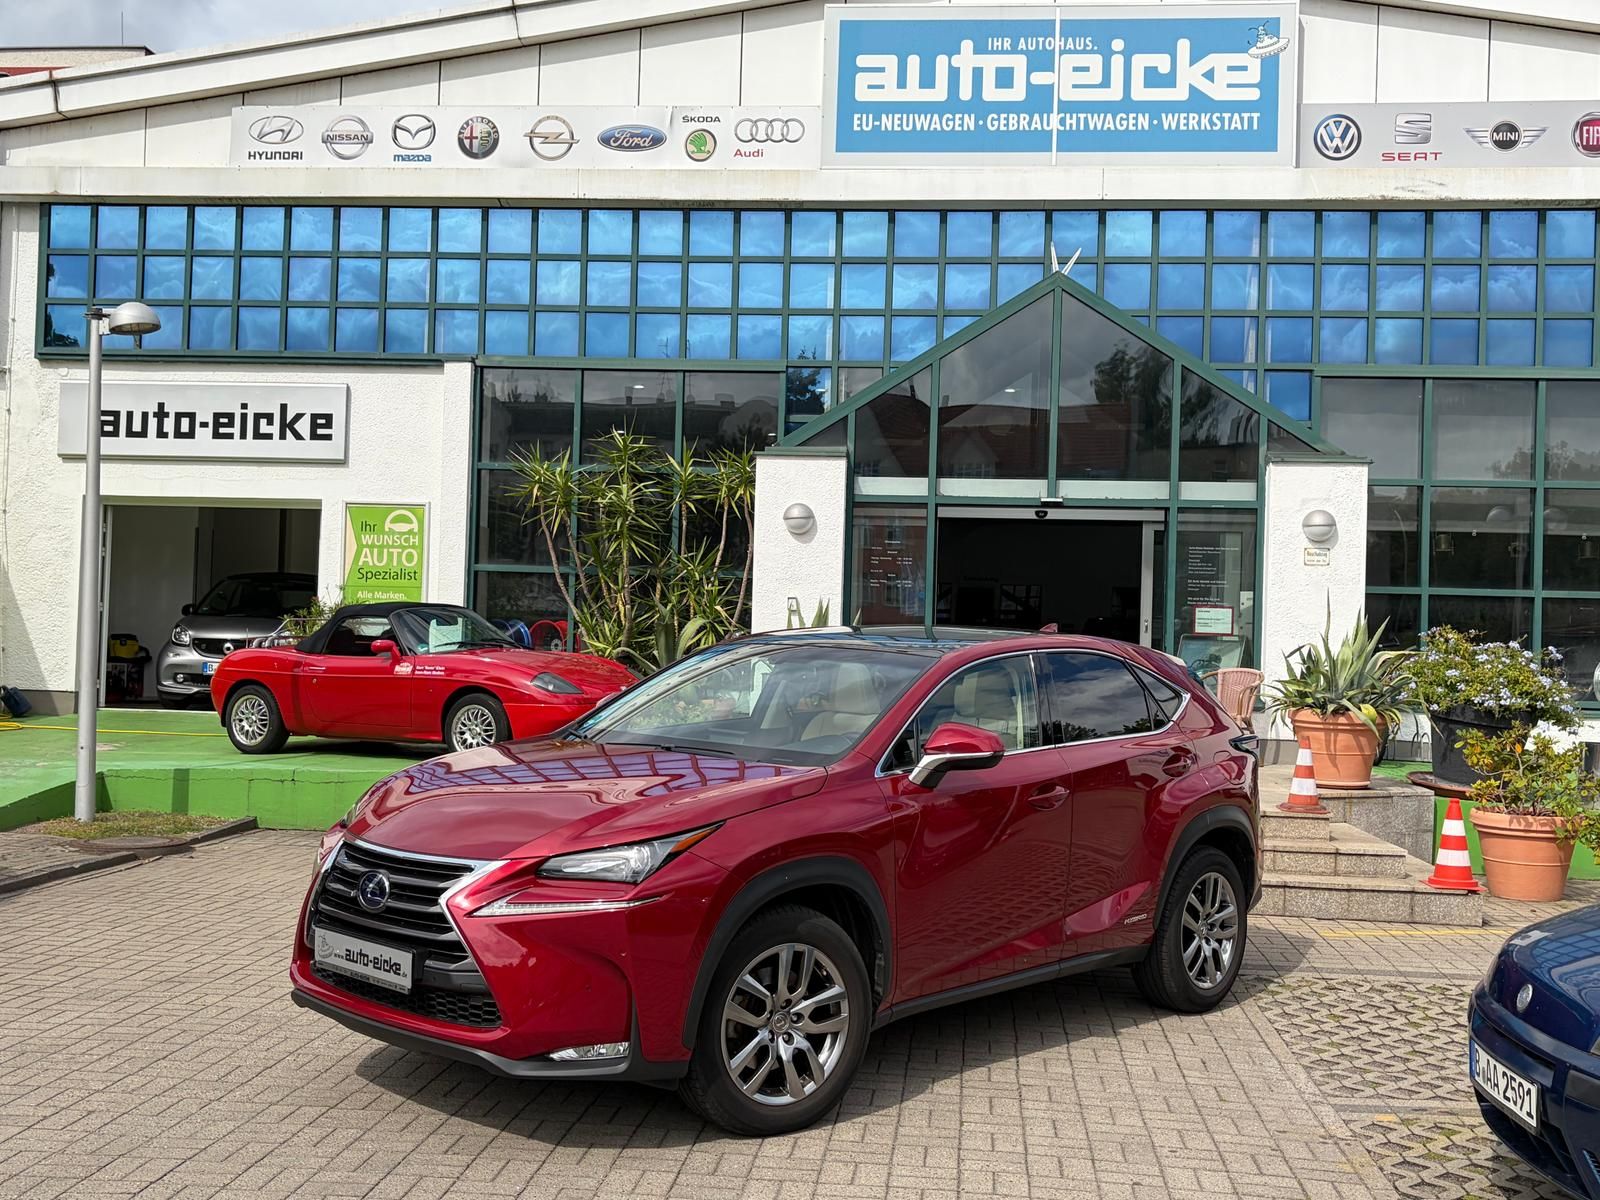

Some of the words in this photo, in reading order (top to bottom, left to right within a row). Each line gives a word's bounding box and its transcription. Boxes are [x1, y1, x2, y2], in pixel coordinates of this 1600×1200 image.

[988, 37, 1011, 50] IHR
[1018, 37, 1098, 51] AUTOHAUS.
[854, 38, 1261, 102] auto-eicke
[682, 115, 721, 123] ŠKODA
[853, 113, 975, 131] EU-NEUWAGEN
[987, 112, 1150, 131] GEBRAUCHTWAGEN
[1162, 112, 1260, 131] WERKSTATT
[326, 133, 369, 141] NISSAN
[610, 127, 653, 147] Ford
[1492, 132, 1519, 142] MINI
[248, 151, 303, 160] HYUNDAI
[733, 149, 764, 158] Audi
[1381, 152, 1443, 162] SEAT
[100, 402, 333, 441] auto-eicke
[360, 520, 377, 532] Ihr
[361, 534, 419, 546] WUNSCH
[358, 548, 418, 567] AUTO
[357, 568, 418, 583] Spezialist
[357, 590, 373, 599] Alle
[374, 591, 407, 600] Marken.
[1502, 1070, 1534, 1120] 2591
